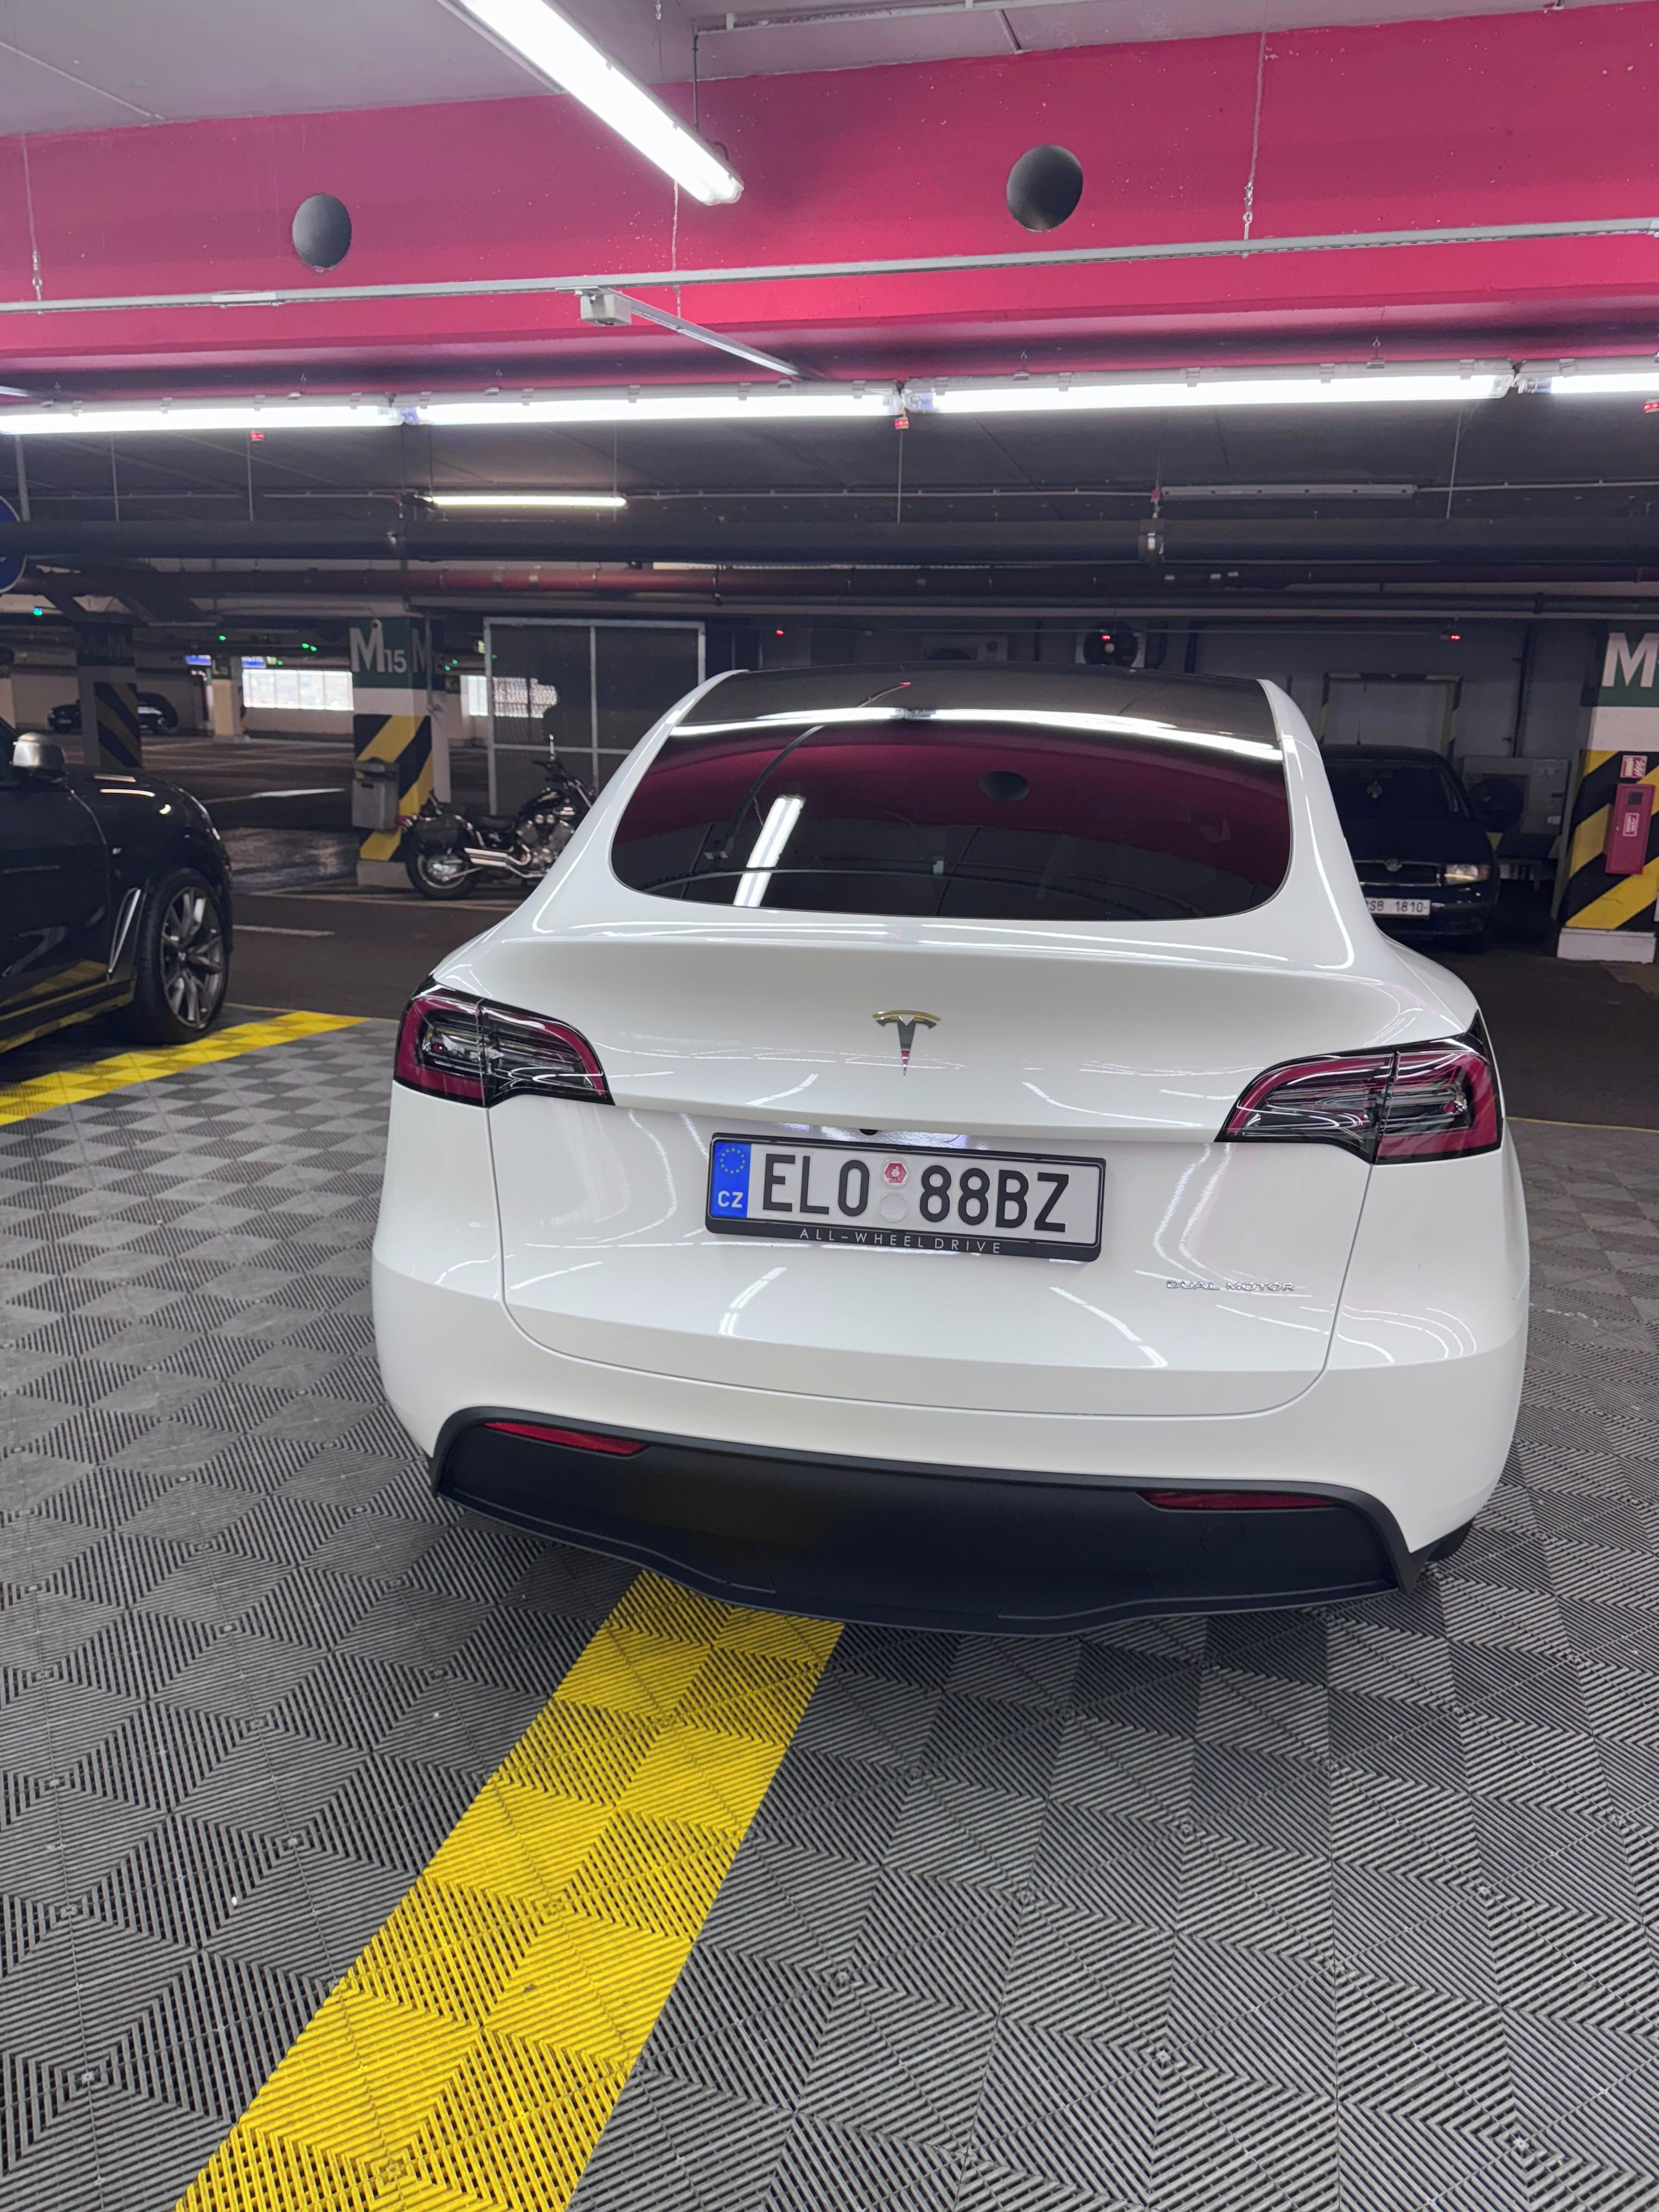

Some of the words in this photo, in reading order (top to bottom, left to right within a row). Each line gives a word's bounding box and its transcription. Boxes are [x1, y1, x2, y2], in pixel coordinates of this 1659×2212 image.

[349, 627, 408, 673] M15
[1601, 632, 1659, 687] M
[1395, 901, 1424, 913] 1810
[717, 1190, 744, 1208] CZ
[919, 1165, 1069, 1233] 88BZ
[1166, 1279, 1221, 1290] DUAL
[1226, 1281, 1295, 1291] MOTOR
